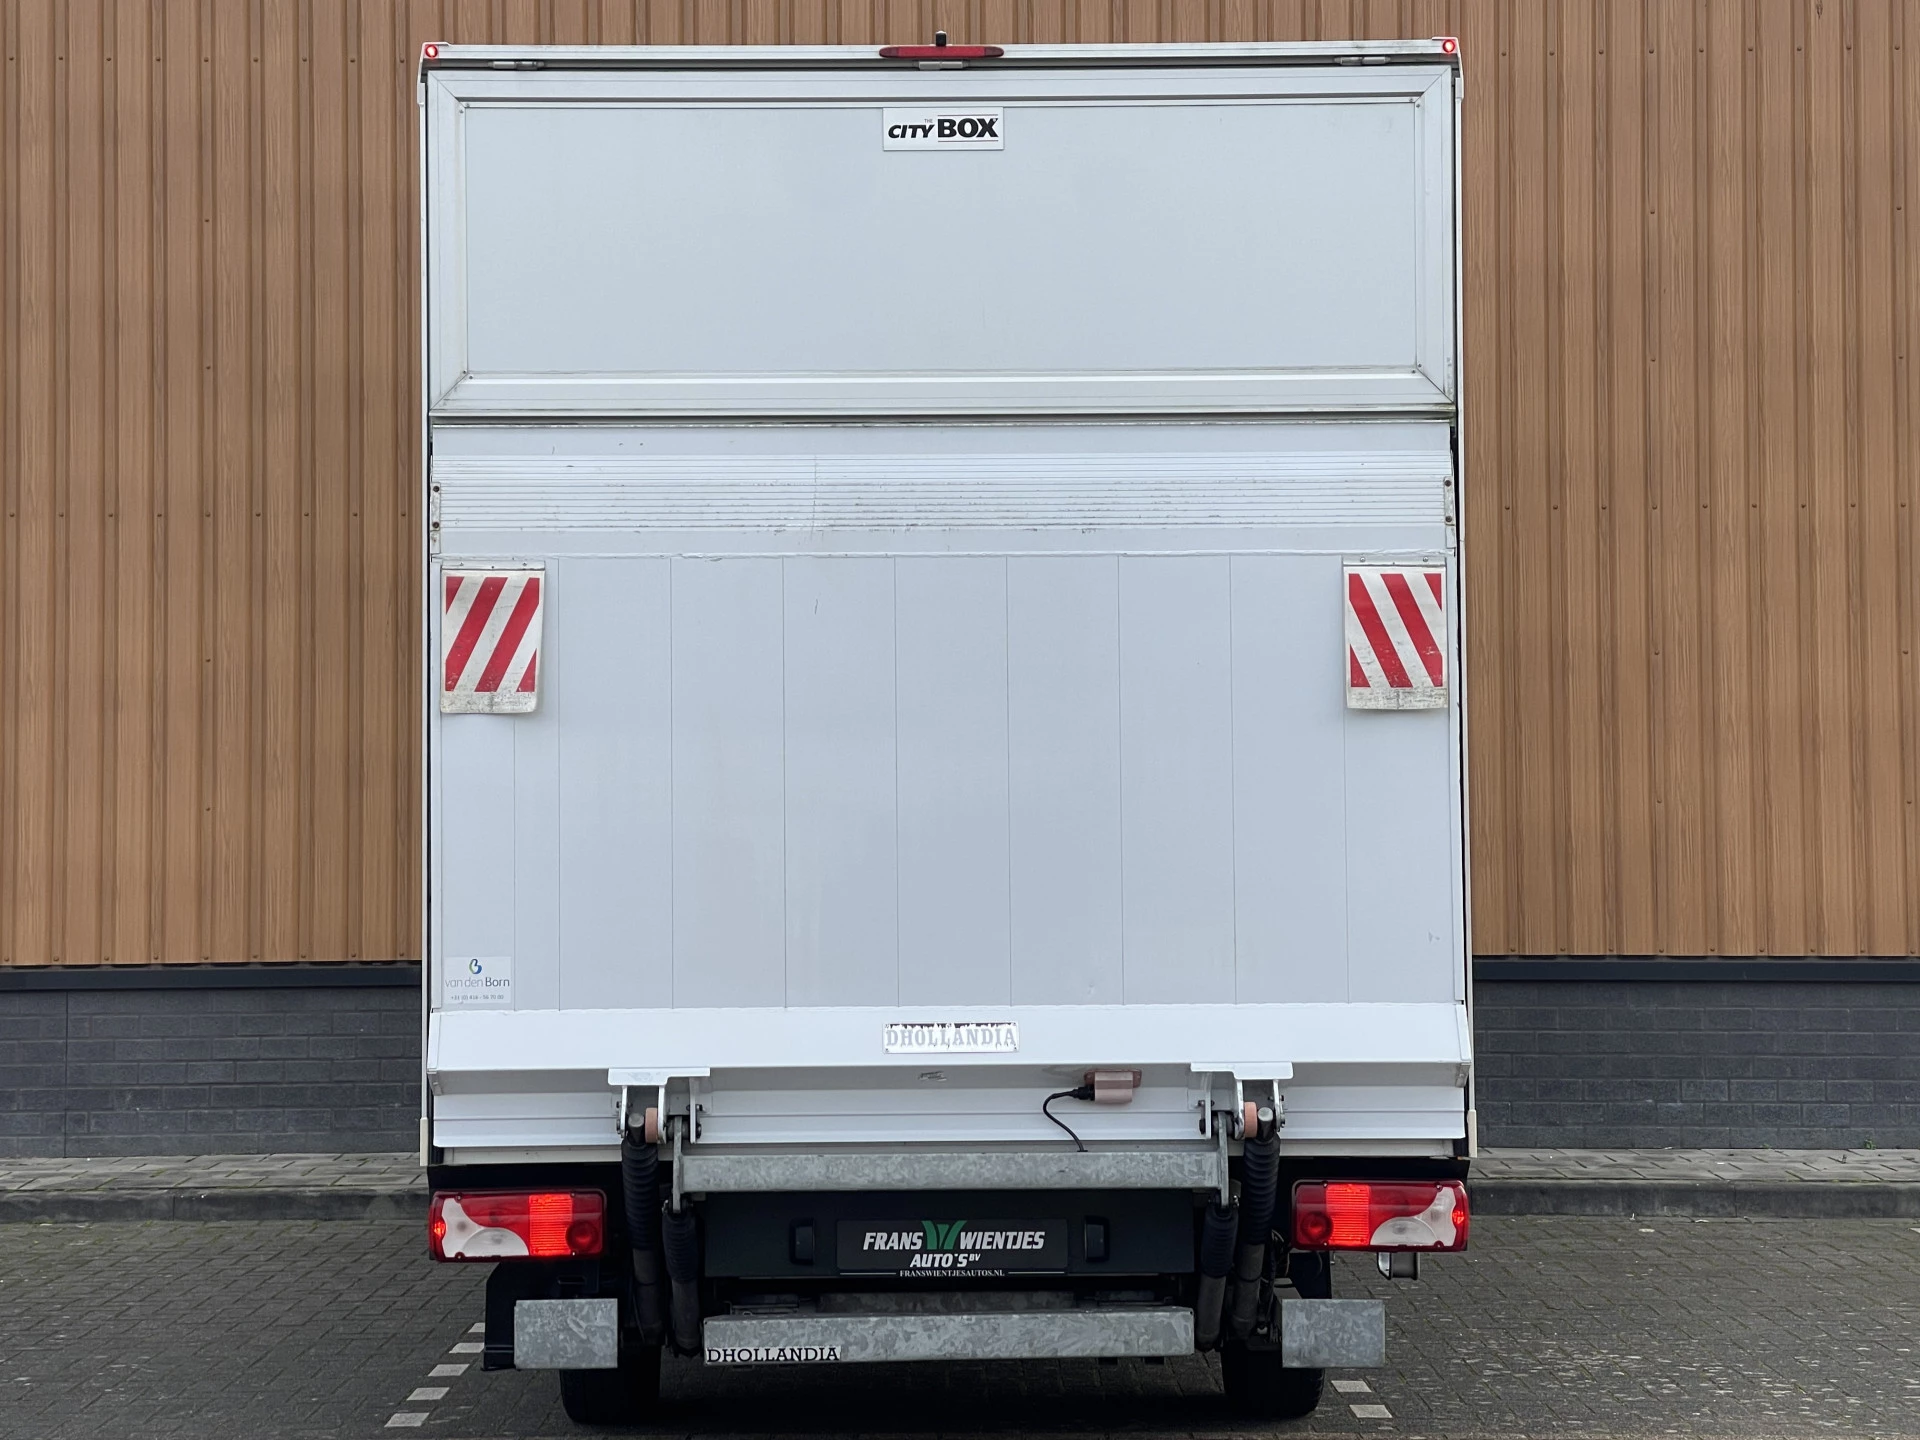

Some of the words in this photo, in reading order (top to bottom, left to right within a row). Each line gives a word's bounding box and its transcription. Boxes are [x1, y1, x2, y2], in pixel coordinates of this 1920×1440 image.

[888, 124, 935, 138] CITY
[937, 118, 999, 138] BOX
[445, 979, 463, 987] van
[464, 977, 483, 987] den
[485, 977, 510, 987] Born
[886, 1027, 1016, 1047] DHOLLANDIA
[863, 1232, 924, 1250] FRANS
[959, 1231, 1045, 1250] WIENTJES
[899, 1269, 1005, 1277] FRANSWIENTJESAUTOS.NL
[707, 1347, 840, 1362] DHOLLANDIA
